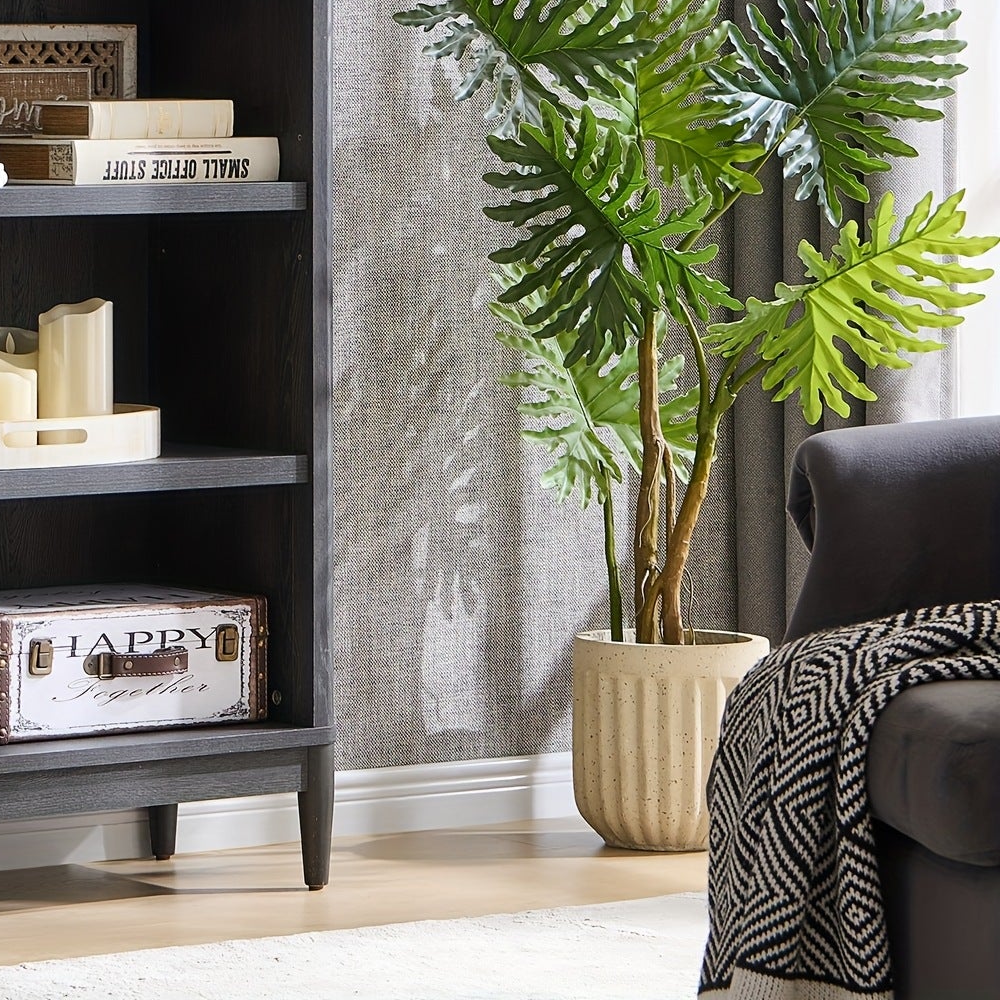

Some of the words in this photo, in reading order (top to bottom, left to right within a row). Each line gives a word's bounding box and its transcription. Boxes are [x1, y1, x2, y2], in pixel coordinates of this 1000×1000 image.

[103, 159, 147, 181] STUFF
[152, 159, 197, 180] OFFICE
[203, 158, 250, 179] SMALL
[52, 674, 210, 707] Together
